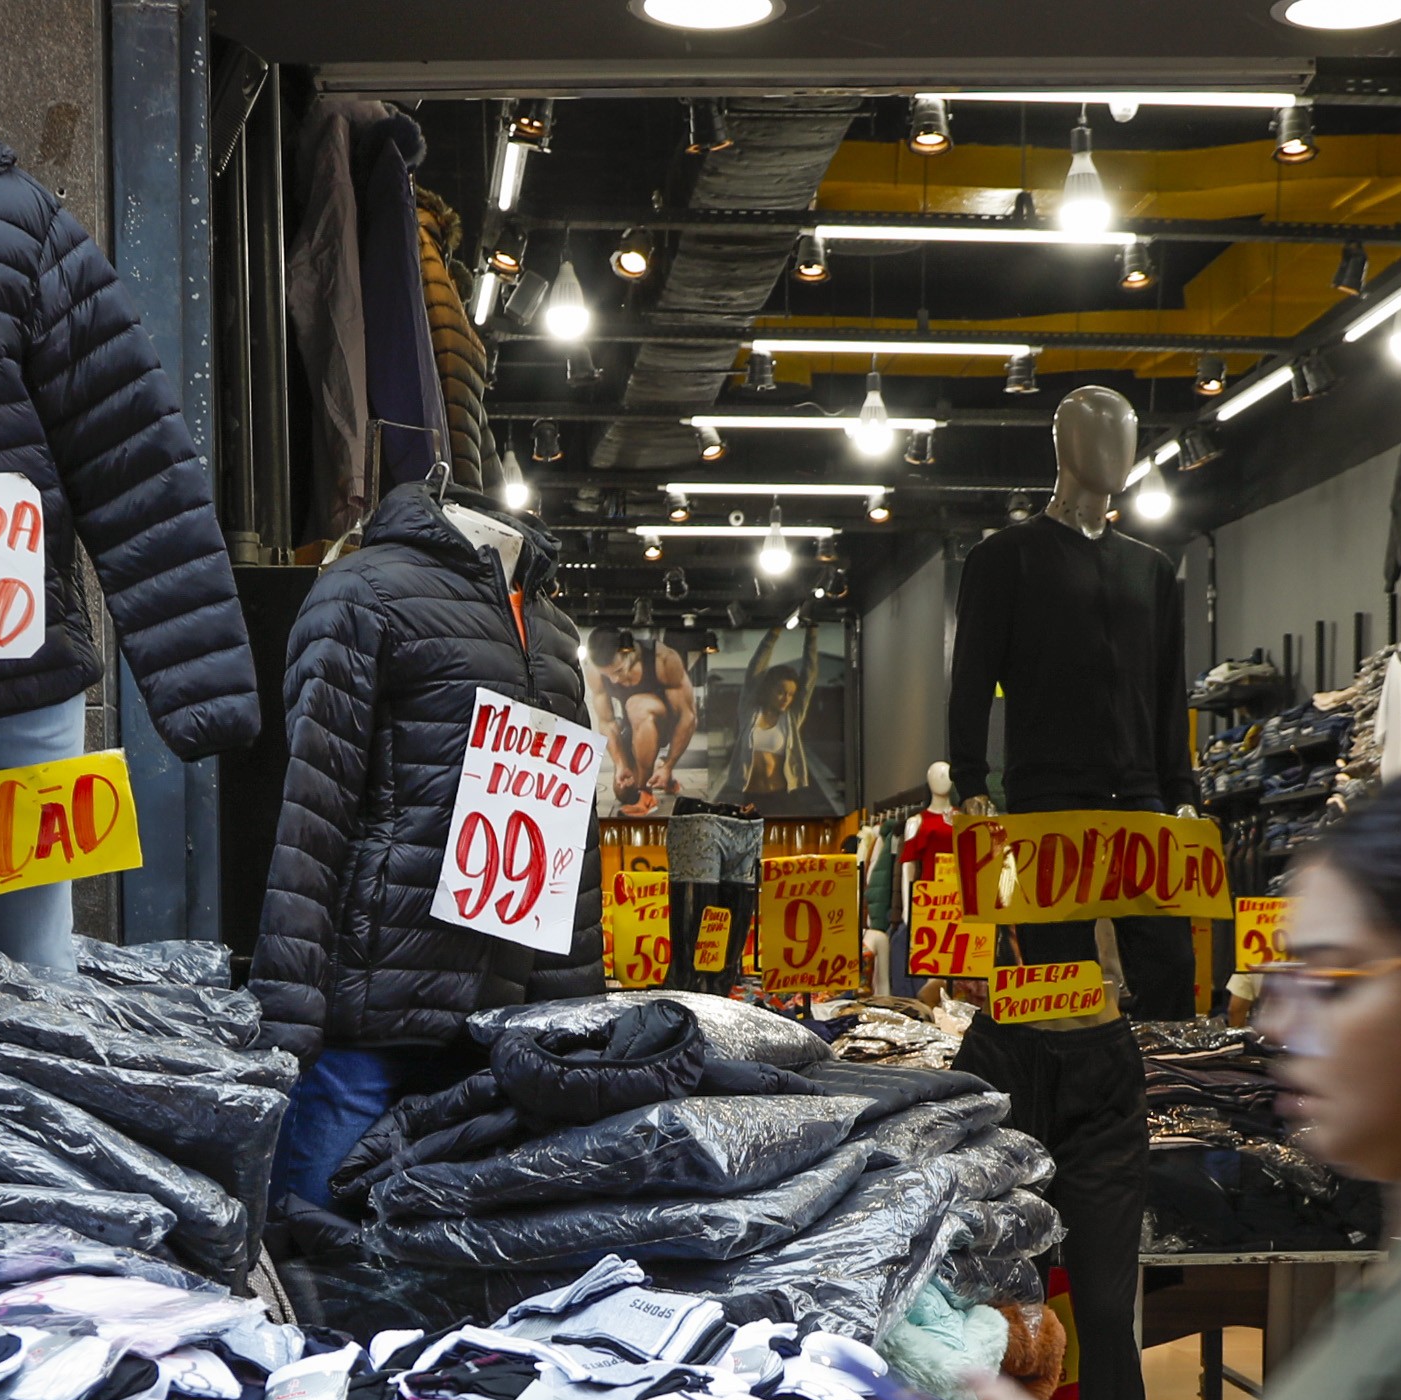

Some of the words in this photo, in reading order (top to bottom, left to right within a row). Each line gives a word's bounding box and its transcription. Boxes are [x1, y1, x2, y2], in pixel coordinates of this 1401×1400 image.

[470, 704, 594, 776] MODELO
[764, 858, 829, 882] BOXER
[956, 821, 1225, 916] PROMOÇÃO
[614, 872, 669, 906] QUEI
[774, 879, 836, 900] LUXO
[912, 882, 960, 906] SUNG
[634, 902, 670, 921] TOT
[995, 964, 1079, 992] MEGA
[993, 987, 1102, 1021] PROMOÇÃO
[629, 1298, 675, 1320] SPORTS
